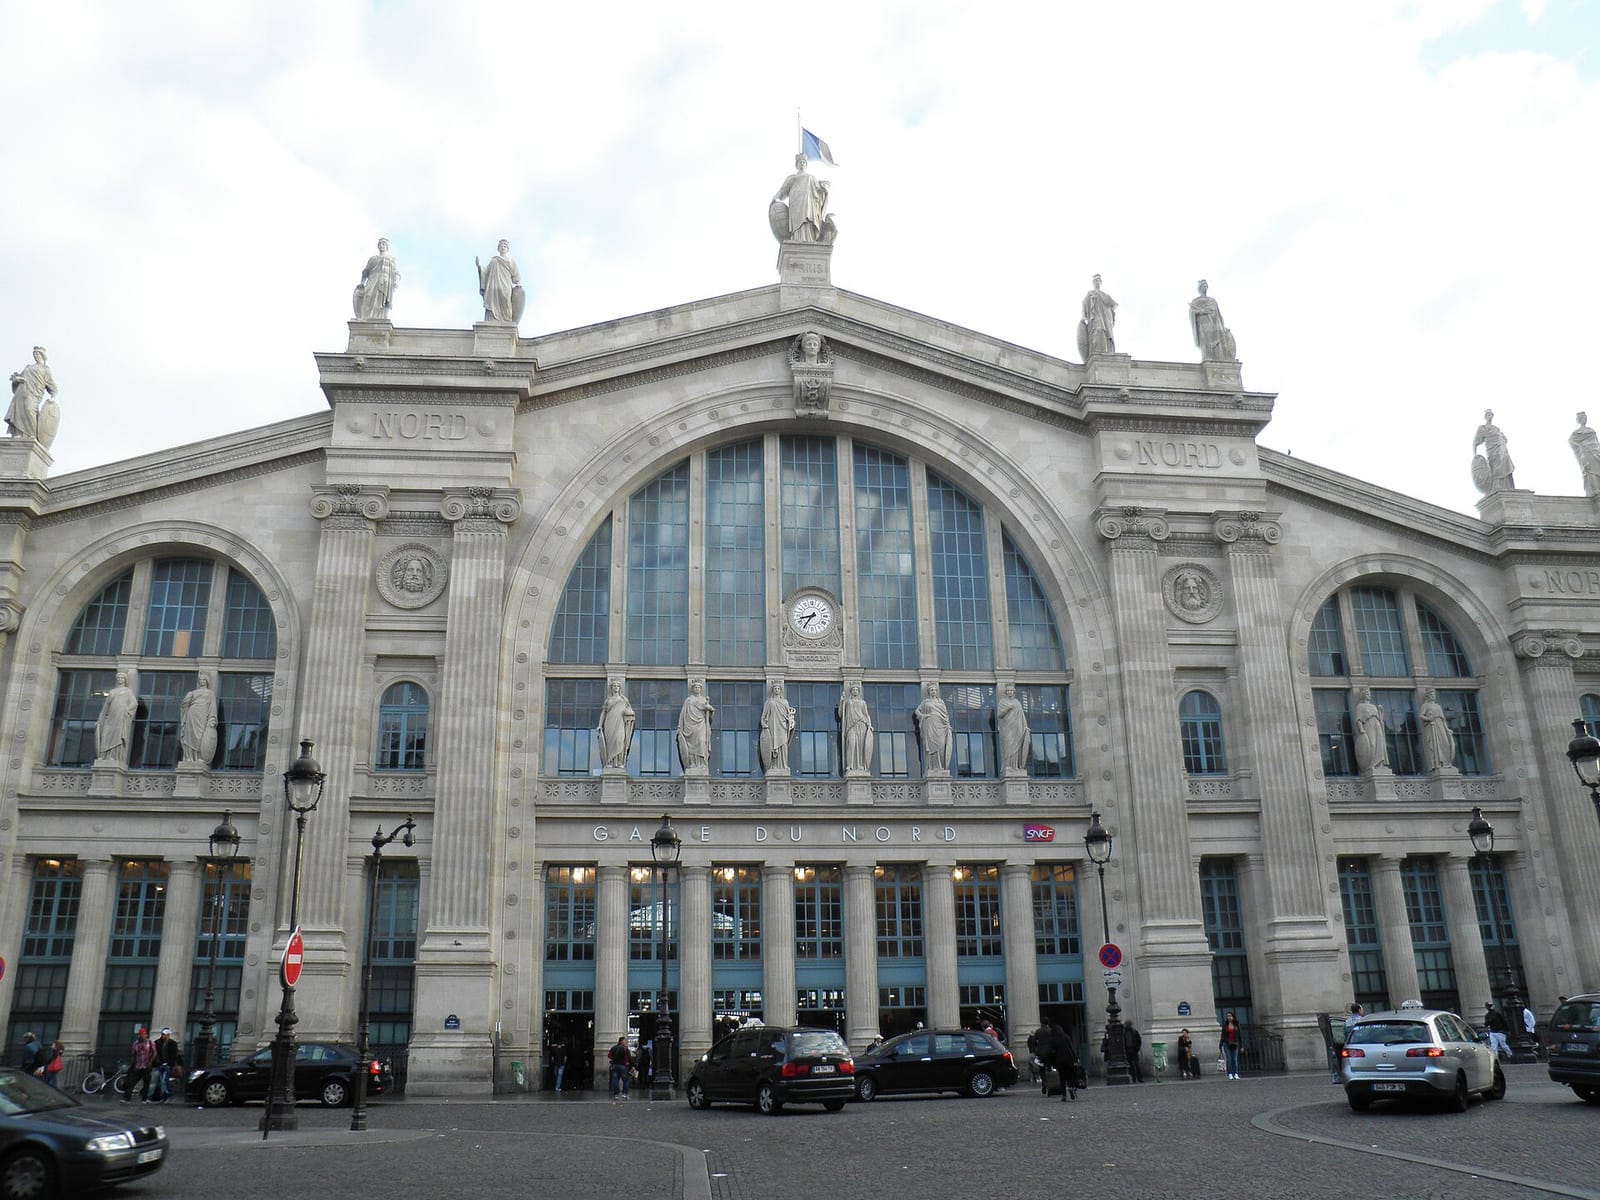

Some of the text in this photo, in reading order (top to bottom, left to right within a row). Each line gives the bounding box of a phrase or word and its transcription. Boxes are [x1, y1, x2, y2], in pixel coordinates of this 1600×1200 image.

[372, 412, 466, 441] NORD
[1136, 440, 1222, 469] NORD
[593, 825, 956, 842] GAE DU NORD
[1026, 829, 1054, 839] SNCF
